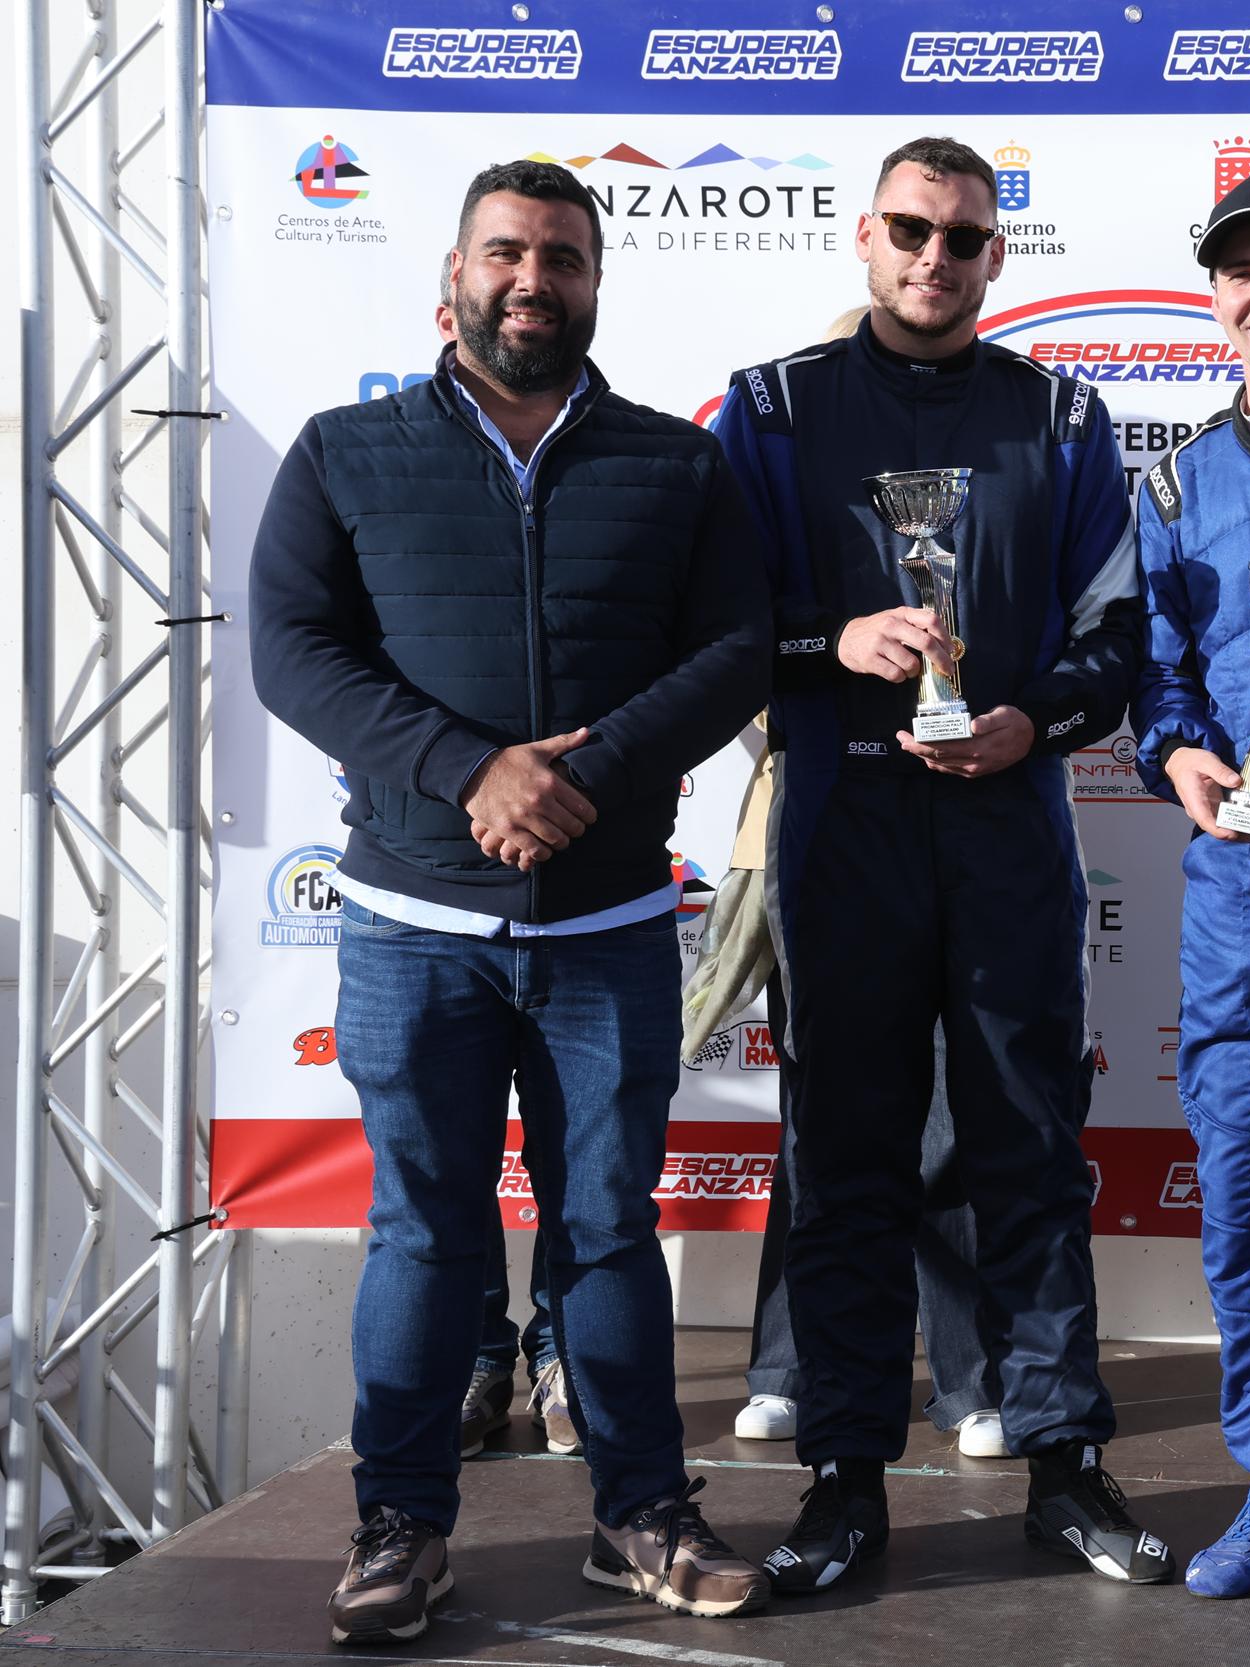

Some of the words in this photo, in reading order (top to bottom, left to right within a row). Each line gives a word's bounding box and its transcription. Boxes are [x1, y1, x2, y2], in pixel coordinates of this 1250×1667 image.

[391, 34, 578, 55] ESCUDERIA
[649, 35, 838, 56] ESCUDERIA
[910, 36, 1100, 57] ESCUDERIA
[387, 53, 577, 74] LANZAROTE
[646, 54, 836, 75] LANZAROTE
[906, 55, 1098, 77] LANZAROTE
[590, 184, 837, 218] NZAROTE
[278, 214, 329, 227] Centros
[334, 216, 349, 228] de
[352, 217, 385, 229] Arte,
[997, 220, 1056, 236] bierno
[275, 228, 322, 241] Cultura
[326, 233, 333, 245] y
[336, 230, 387, 243] Turismo
[658, 232, 837, 251] DIFERENTE
[1005, 239, 1066, 255] narias
[1052, 364, 1245, 382] ANZAROTE
[745, 368, 774, 415] sparco
[779, 636, 826, 654] sparco
[681, 929, 696, 941] de
[661, 1157, 778, 1176] ESCUD
